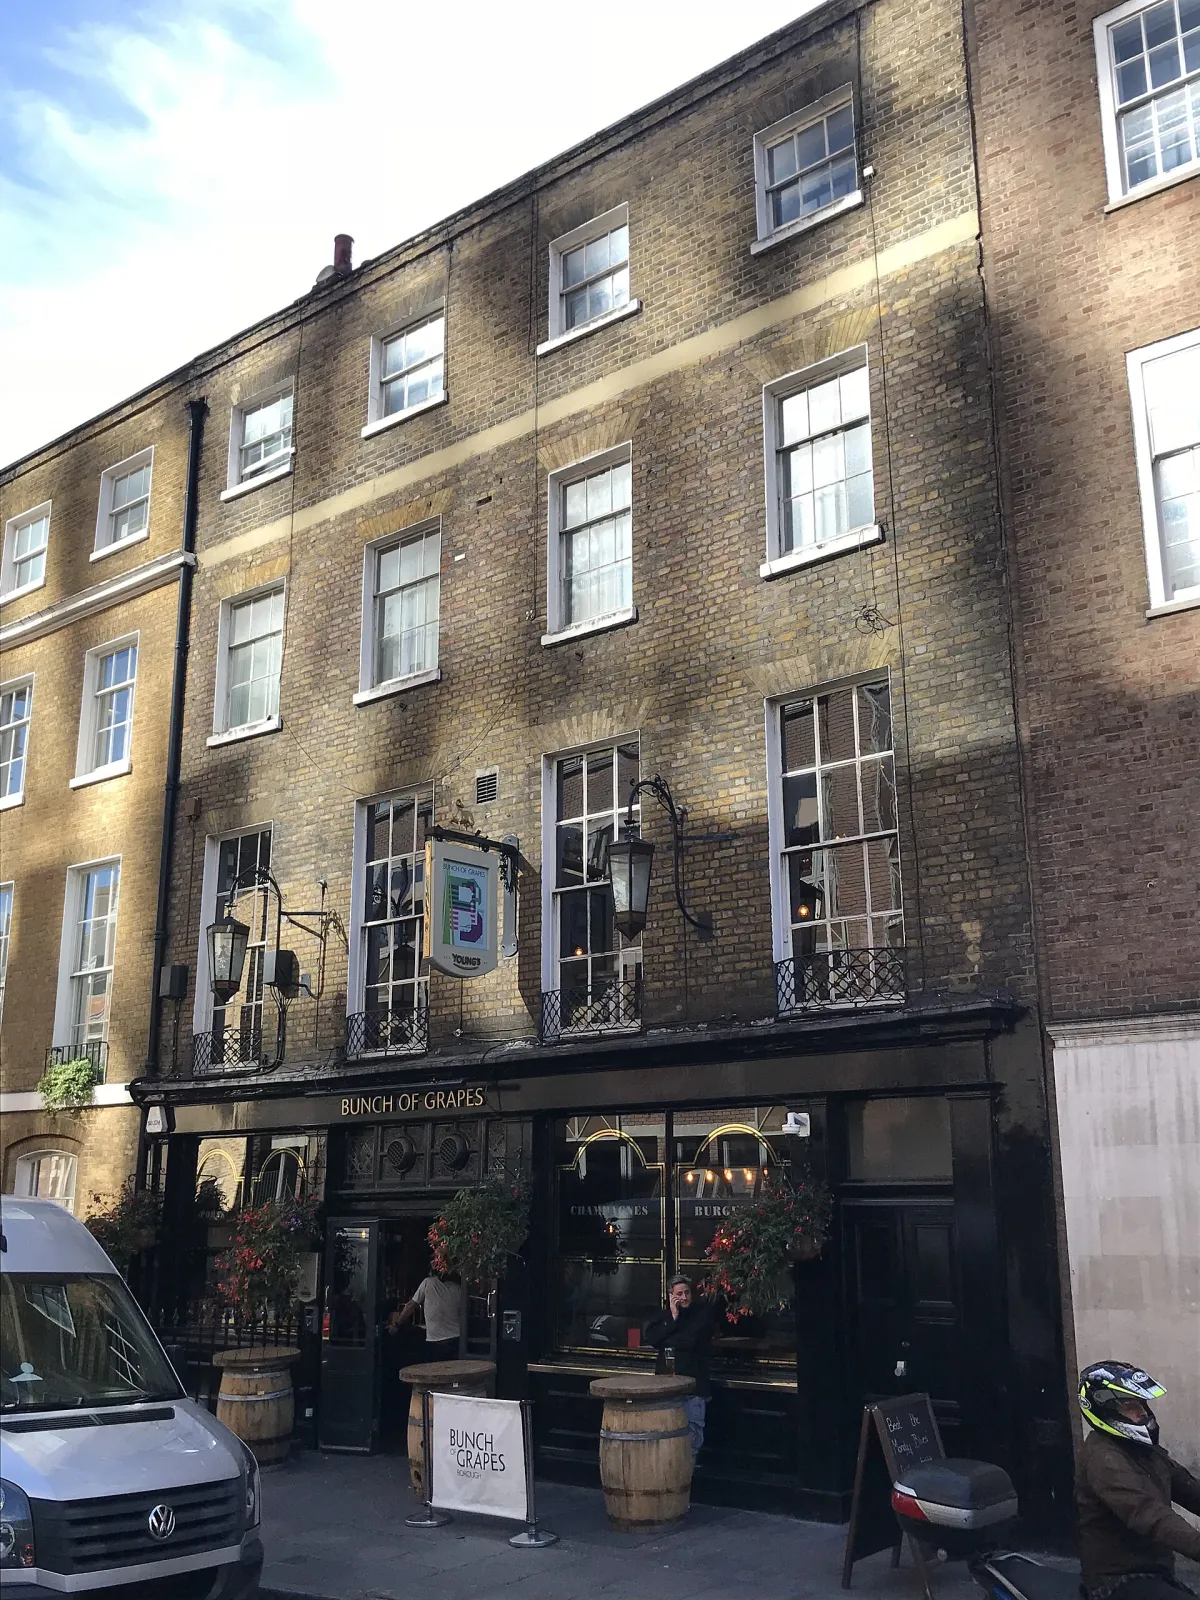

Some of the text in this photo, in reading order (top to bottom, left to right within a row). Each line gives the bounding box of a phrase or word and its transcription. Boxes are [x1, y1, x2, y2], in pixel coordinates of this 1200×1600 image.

[468, 868, 486, 877] GRAPES
[341, 1087, 484, 1116] BUNCH OF GRAPES
[570, 1205, 648, 1216] CHAMPAGNES
[885, 1413, 921, 1433] Beat the
[450, 1428, 494, 1452] BUNCH
[456, 1449, 506, 1472] GRAPES
[456, 1469, 482, 1479] BOROUGH
